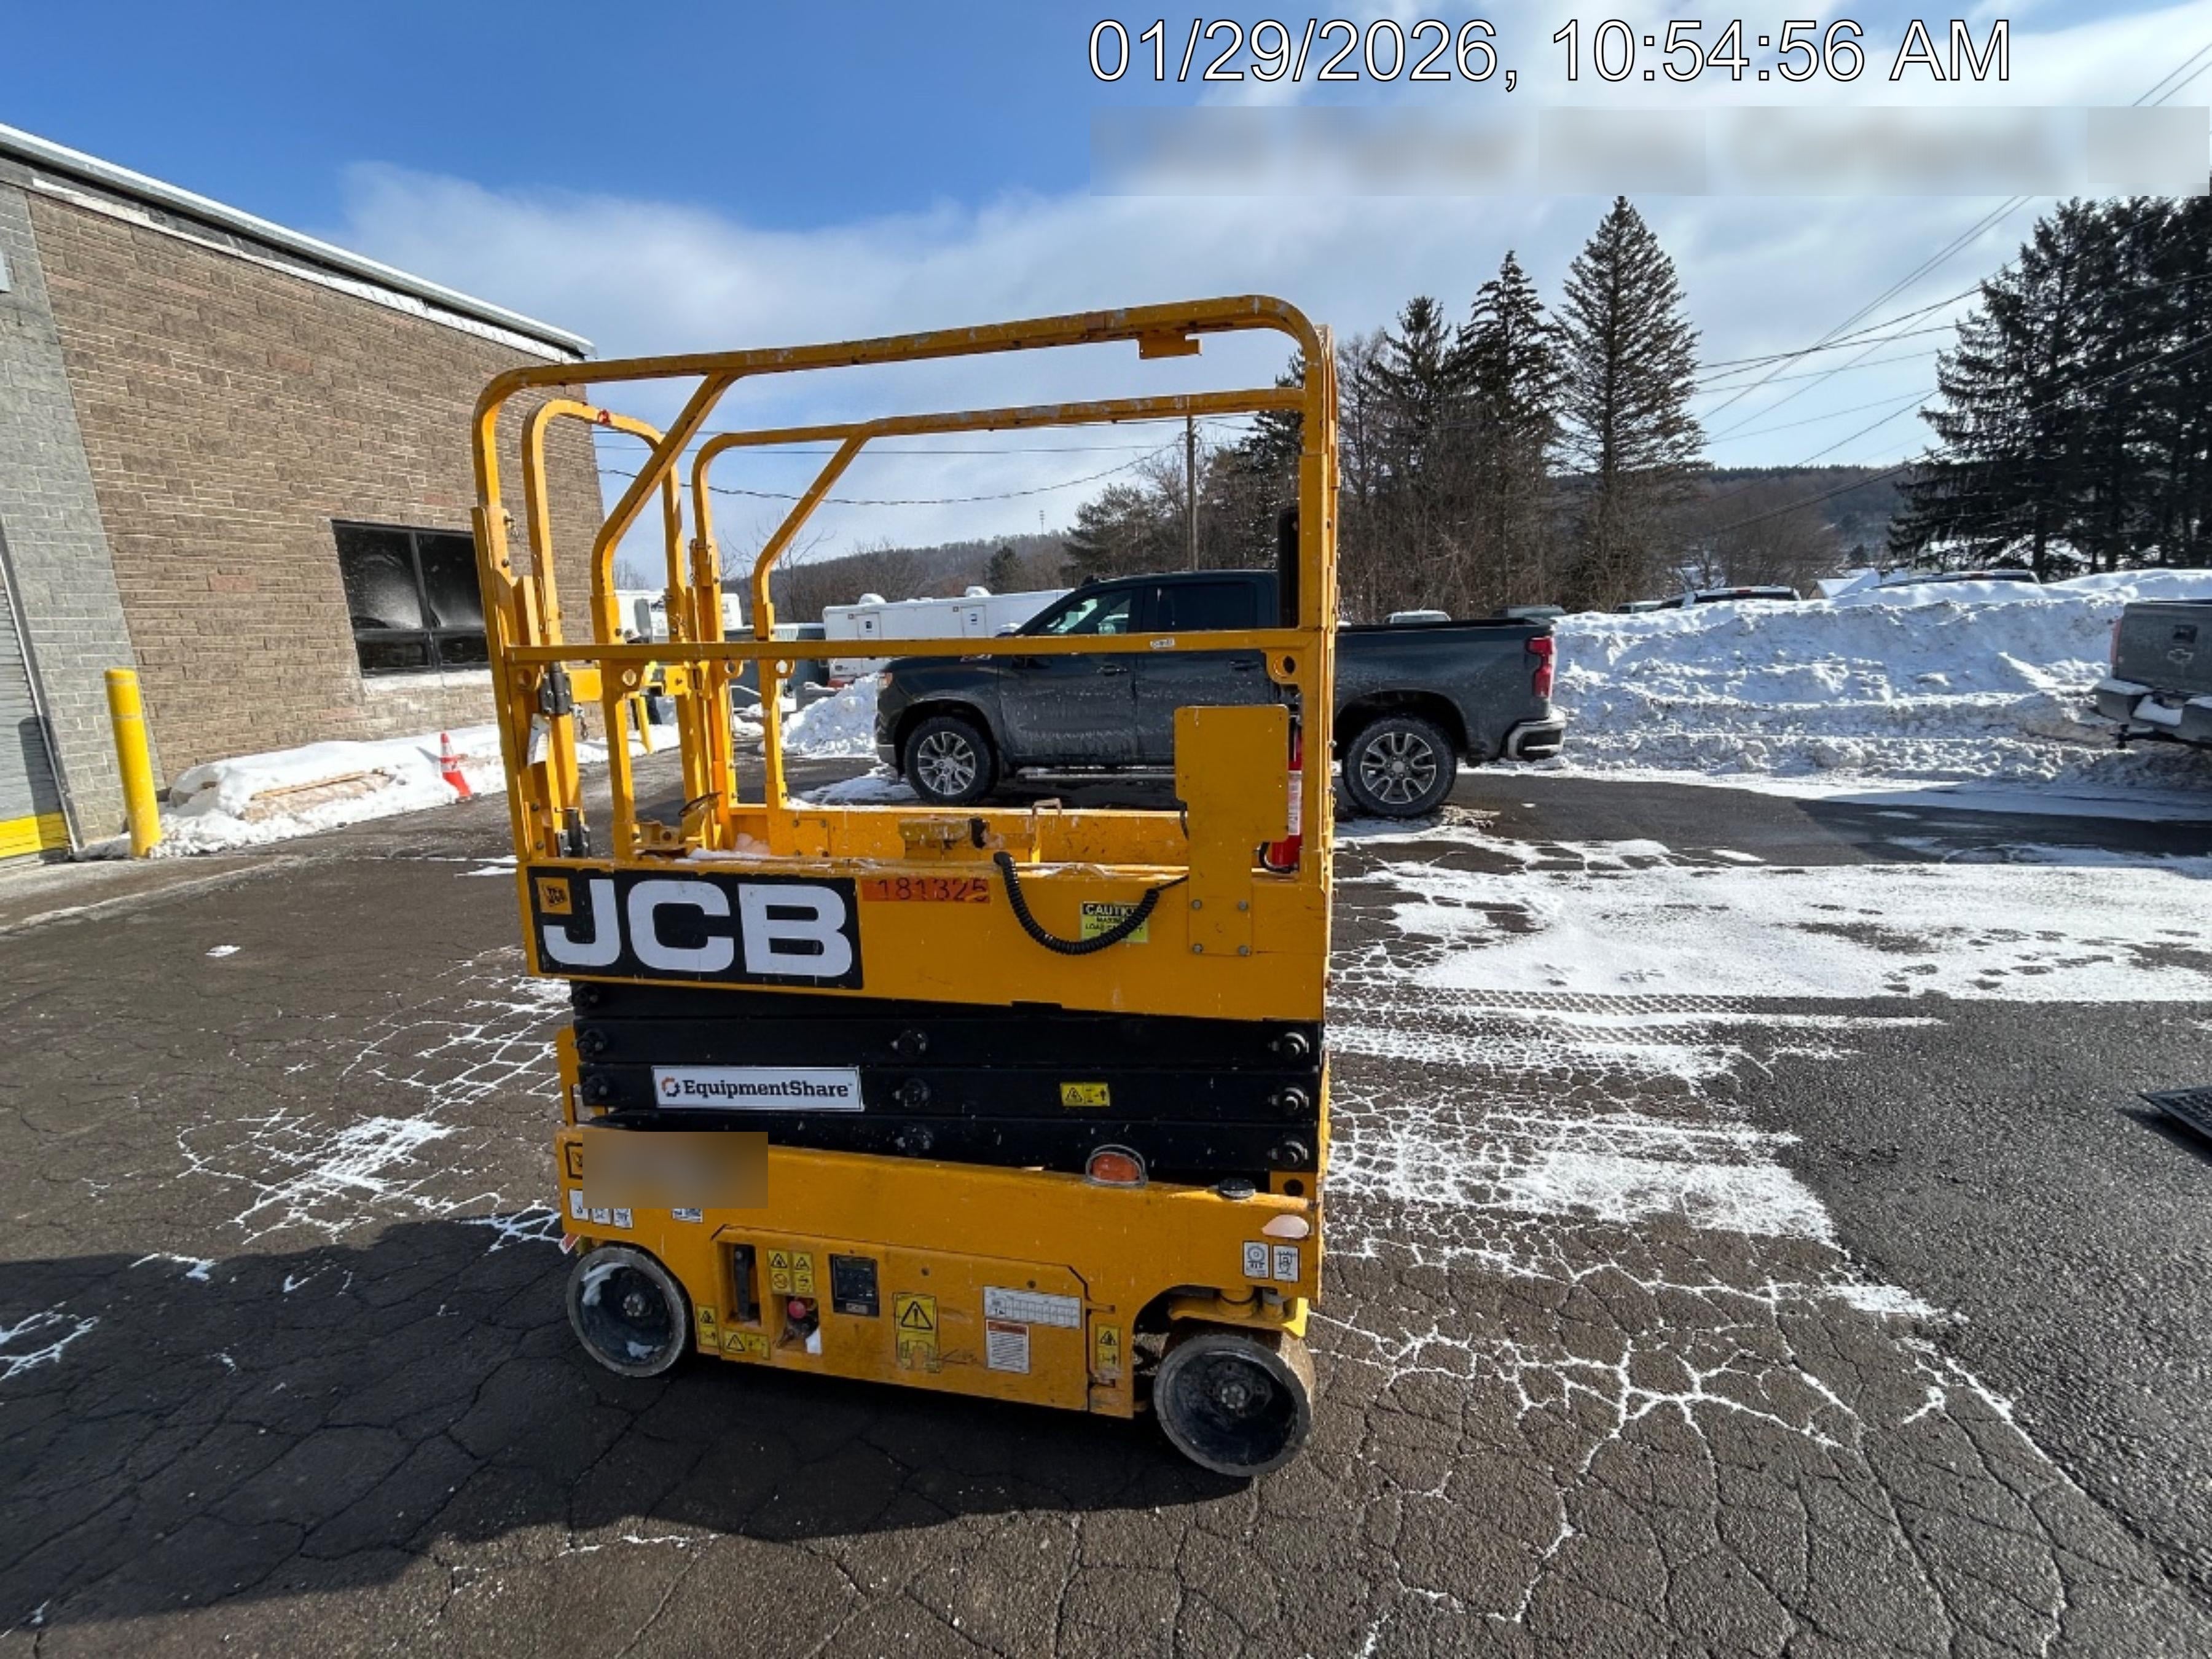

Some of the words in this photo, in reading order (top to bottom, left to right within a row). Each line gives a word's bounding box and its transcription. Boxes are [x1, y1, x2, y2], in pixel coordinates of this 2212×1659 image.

[877, 877, 987, 901] 181325
[1085, 904, 1135, 916] CAUTIO
[543, 879, 853, 977] JCB
[683, 1079, 849, 1099] EquipmentShare
